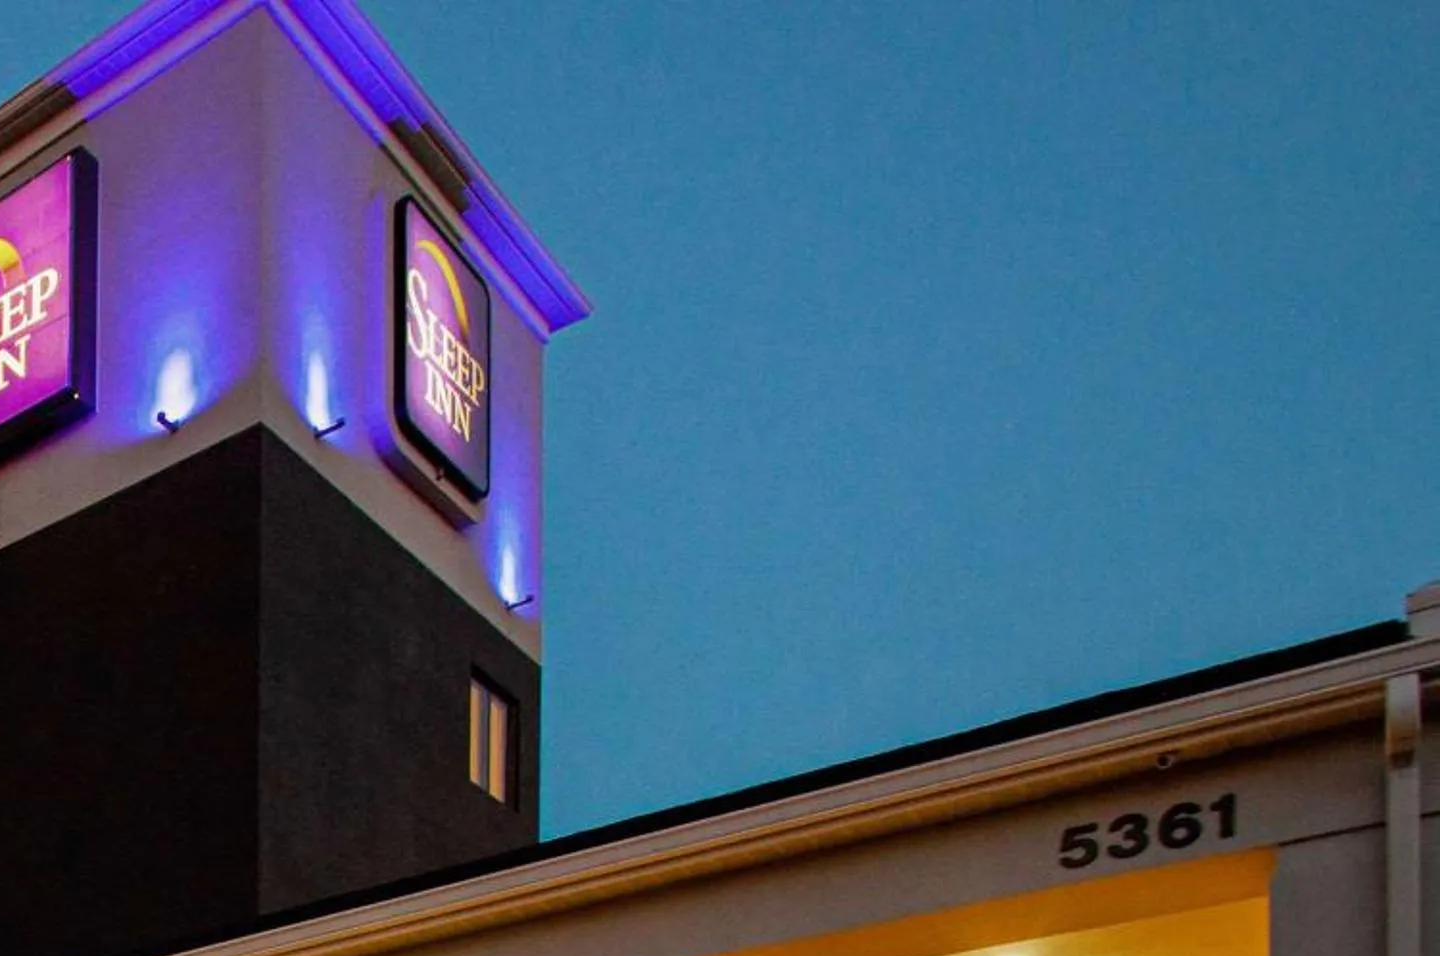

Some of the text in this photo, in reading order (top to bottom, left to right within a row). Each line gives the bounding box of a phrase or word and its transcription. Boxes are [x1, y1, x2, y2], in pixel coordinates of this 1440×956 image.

[407, 268, 484, 406] SLEEP
[425, 360, 471, 442] INN
[1059, 792, 1237, 869] 5361
